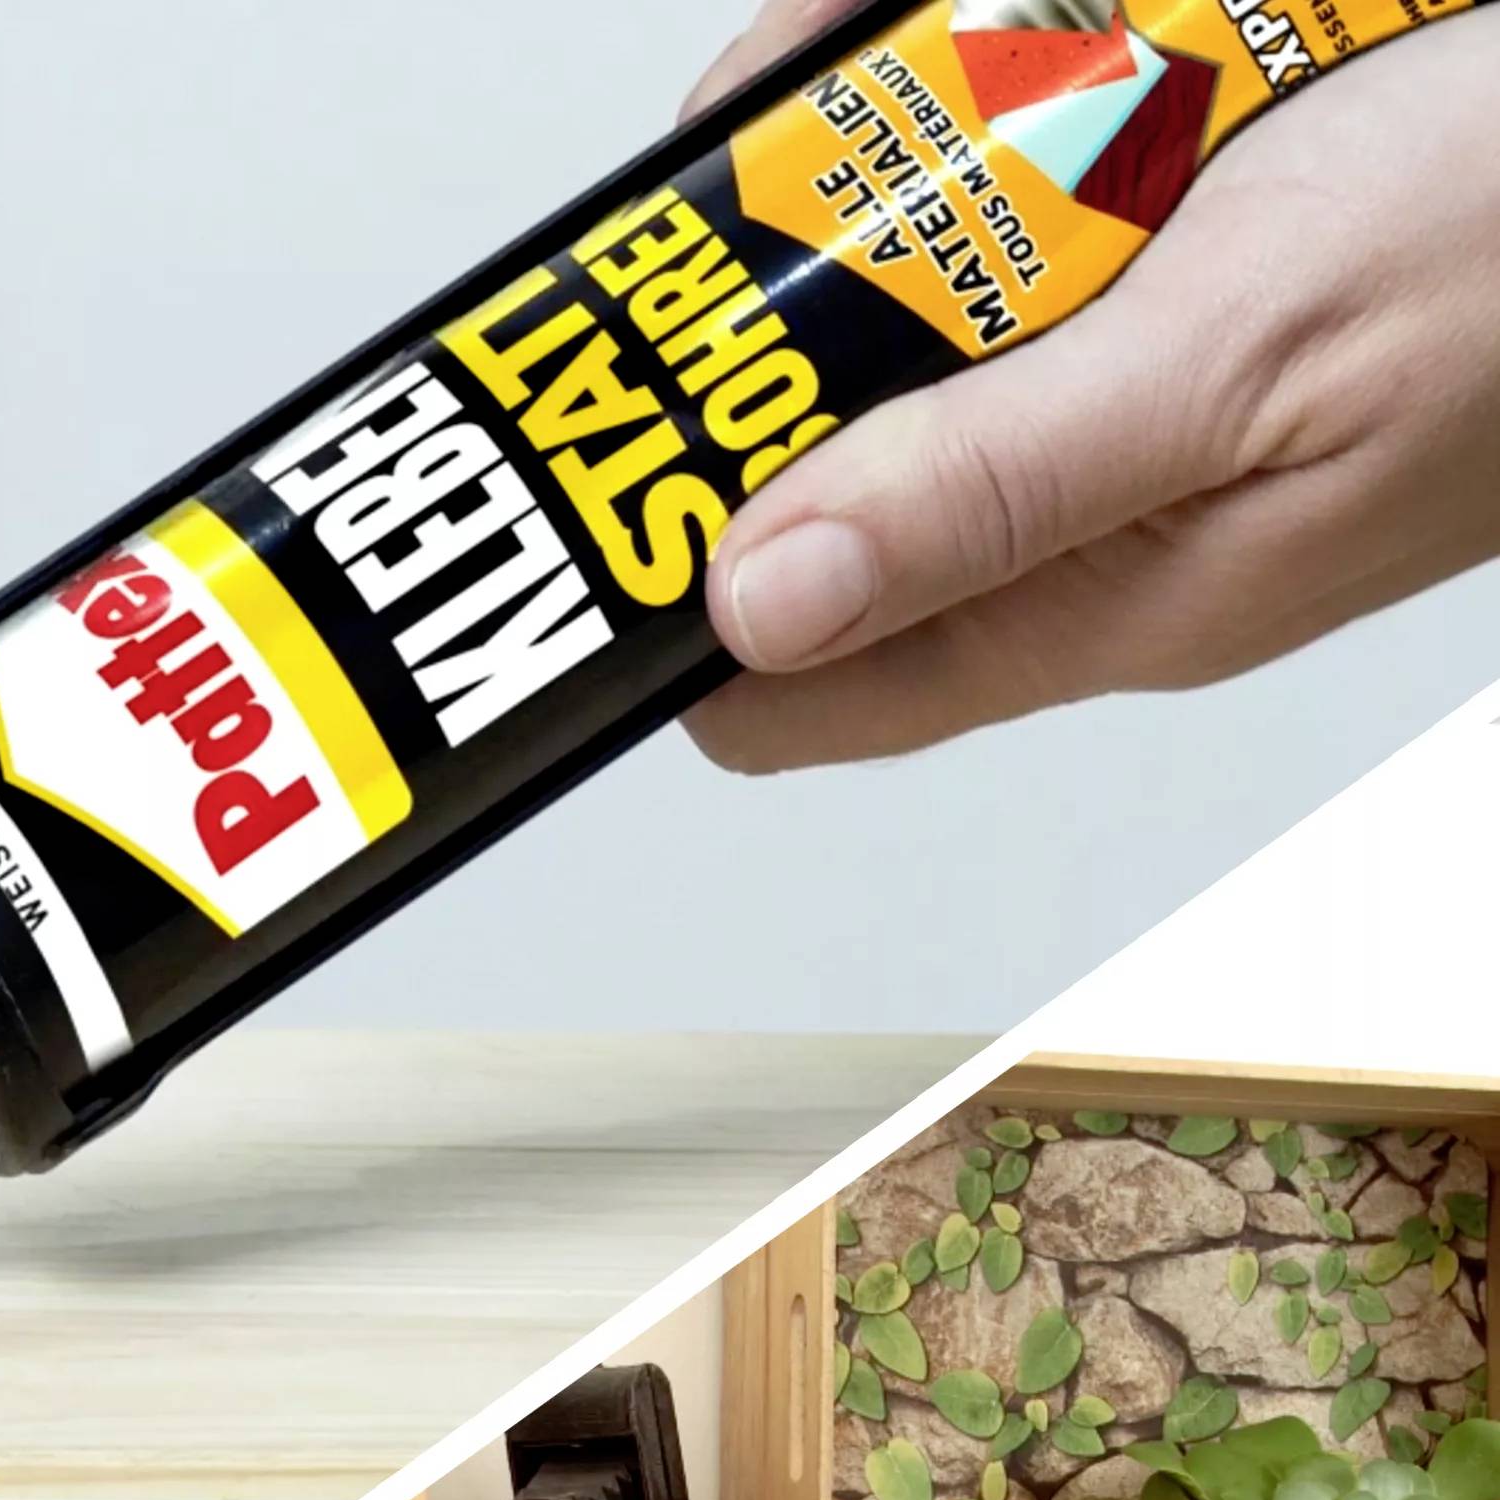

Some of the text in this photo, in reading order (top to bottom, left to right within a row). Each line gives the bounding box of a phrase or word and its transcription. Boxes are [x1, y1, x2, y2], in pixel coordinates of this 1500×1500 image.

[804, 71, 1017, 344] MATERIALIEN
[815, 160, 913, 264] ALLE
[981, 195, 1045, 287] TOUS
[52, 543, 321, 877] Pattex
